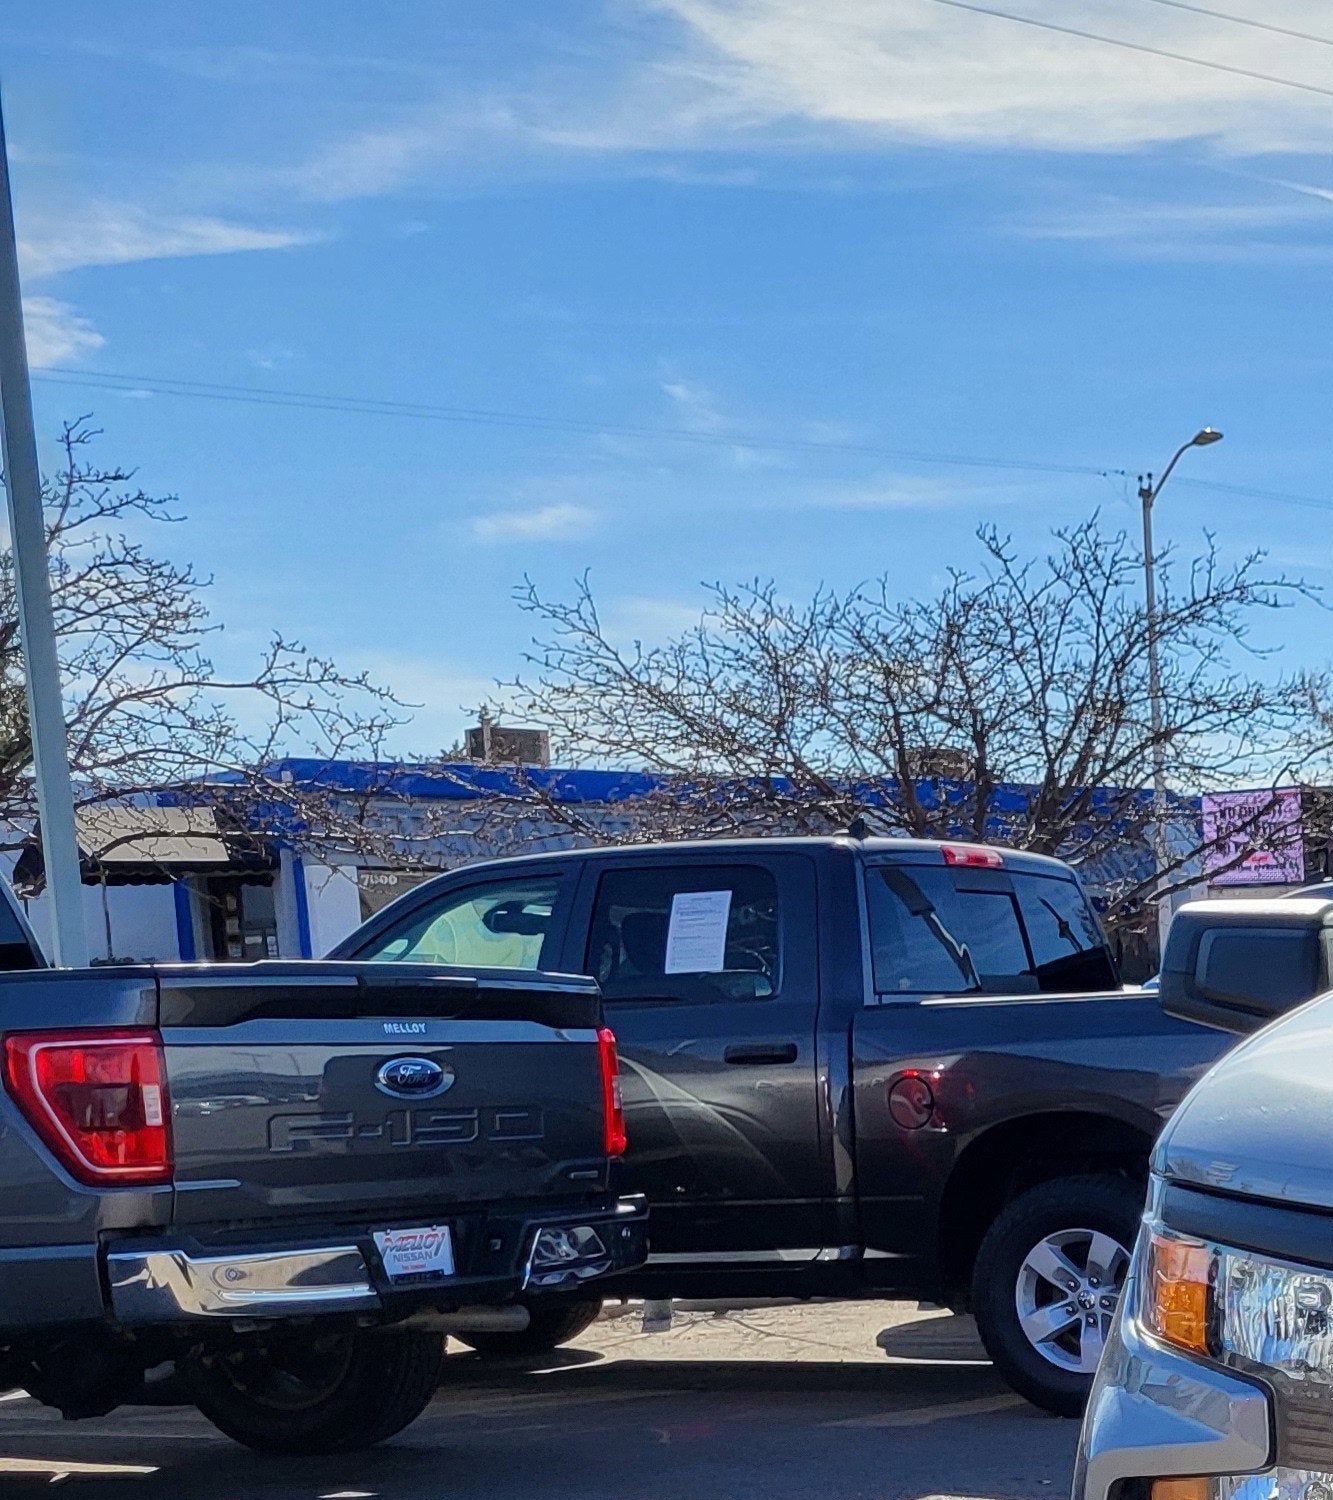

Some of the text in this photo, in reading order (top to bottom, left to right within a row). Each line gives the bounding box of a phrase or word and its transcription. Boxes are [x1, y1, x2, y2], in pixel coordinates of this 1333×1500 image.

[383, 1022, 427, 1034] MELLOY
[266, 1107, 545, 1152] F-150
[392, 1250, 434, 1263] NISSAN
